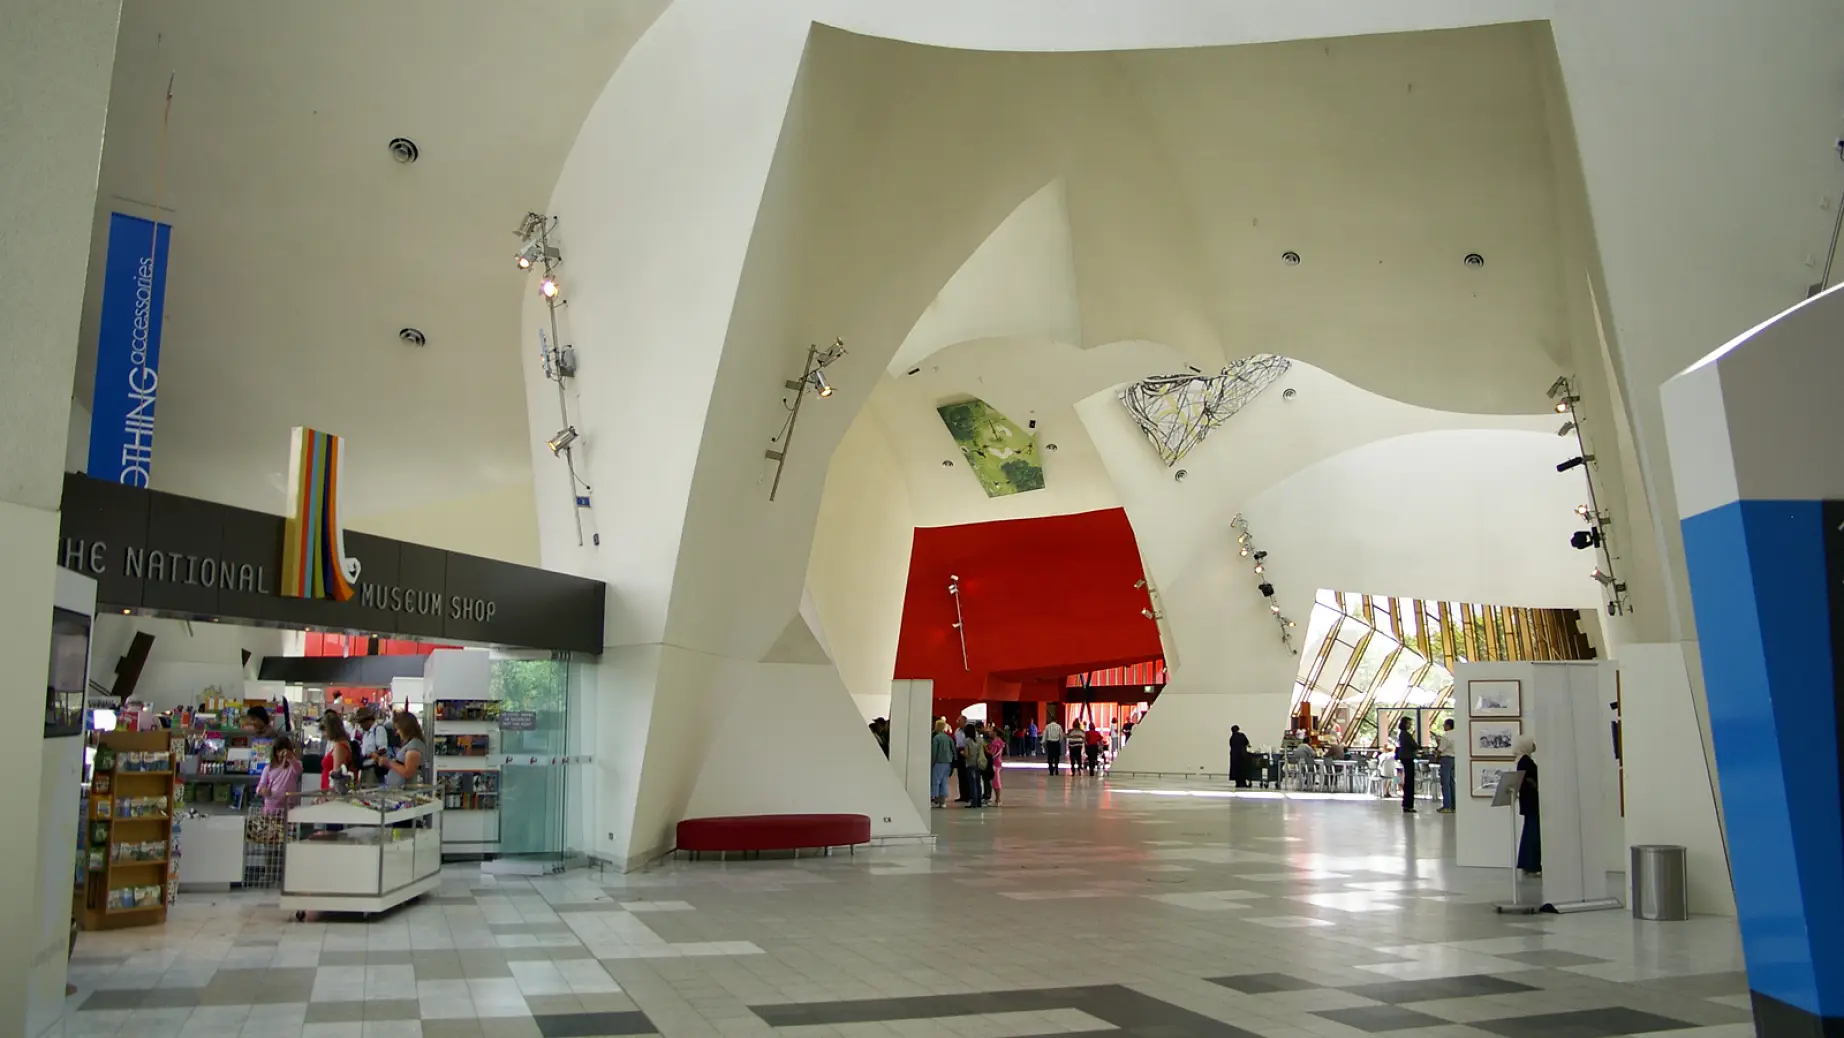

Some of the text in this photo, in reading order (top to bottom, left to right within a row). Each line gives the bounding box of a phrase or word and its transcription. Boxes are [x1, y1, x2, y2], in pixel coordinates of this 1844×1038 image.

[120, 257, 158, 489] OTHING accessories
[64, 537, 496, 622] HE NATIONAL MUSEUM SHOP
